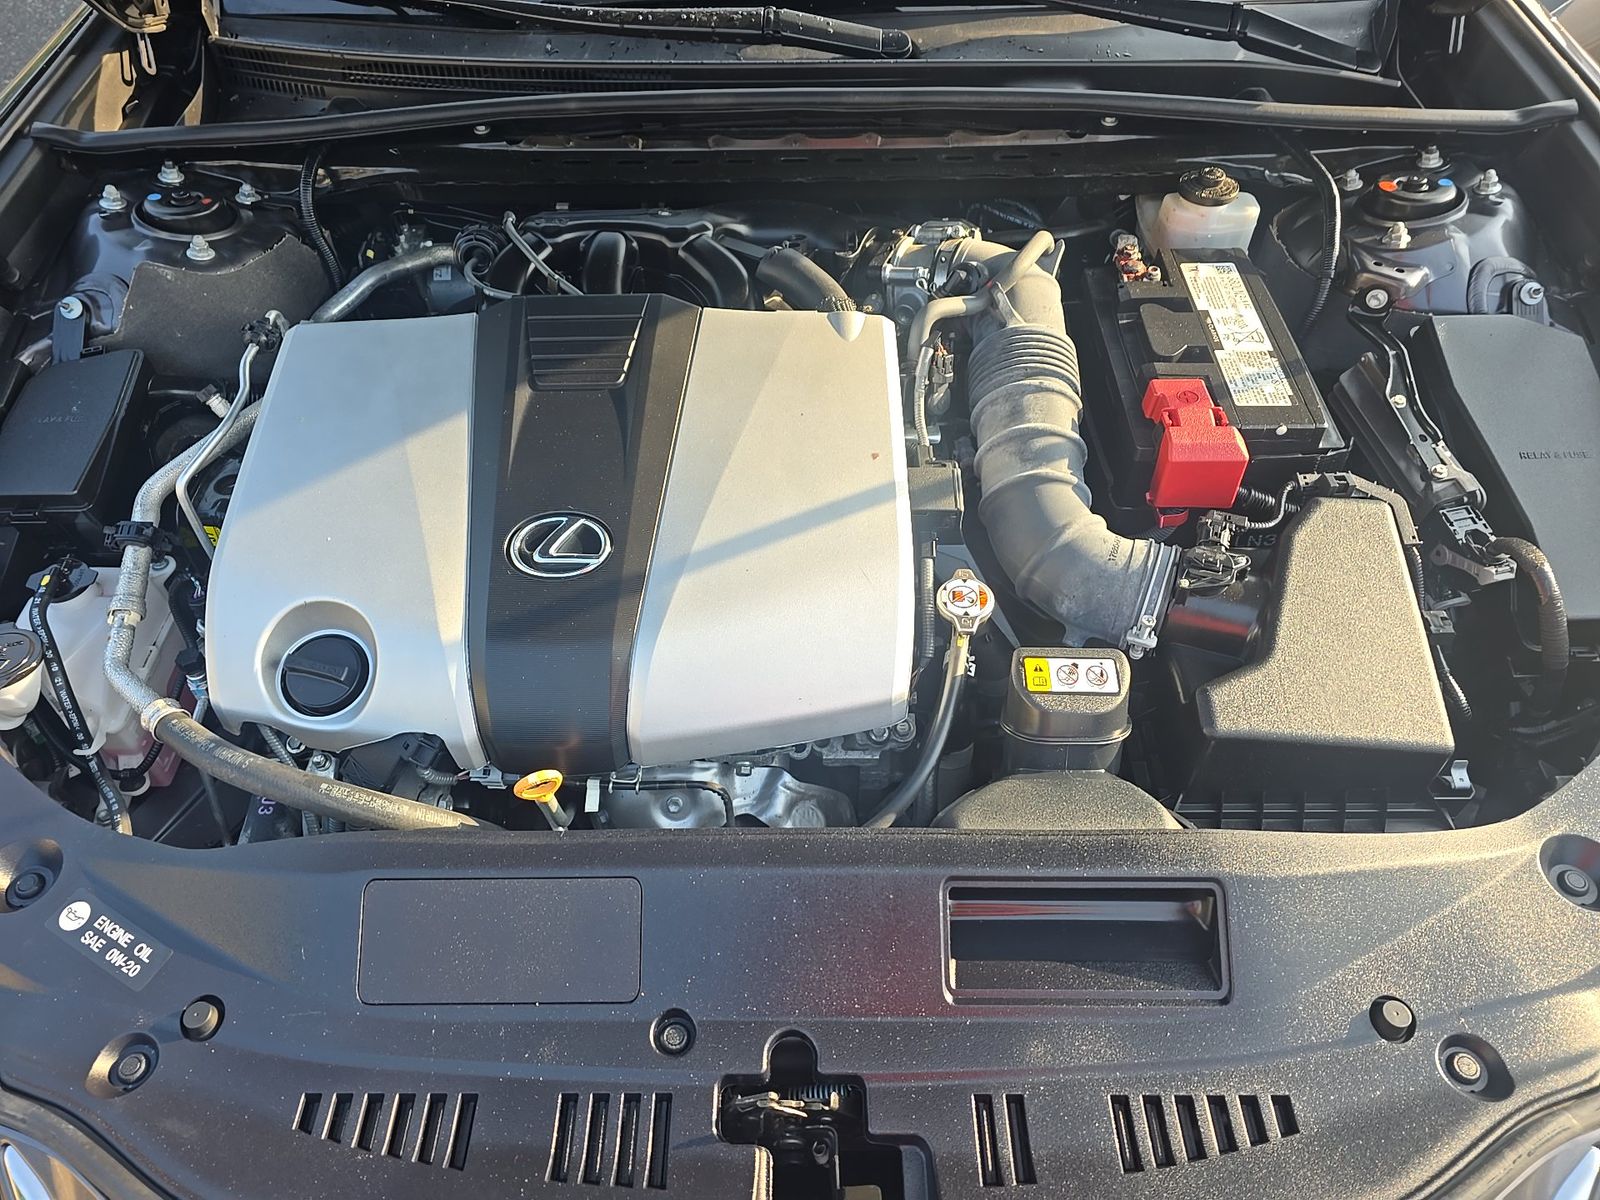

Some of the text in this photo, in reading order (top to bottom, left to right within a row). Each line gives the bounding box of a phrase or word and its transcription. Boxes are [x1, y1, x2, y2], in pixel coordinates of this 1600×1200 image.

[1518, 451, 1551, 460] RELAY
[1563, 450, 1593, 460] FUSE
[59, 688, 74, 711] WATER
[80, 930, 142, 978] SAE 0W-20
[93, 915, 154, 964] ENGINE OIL
